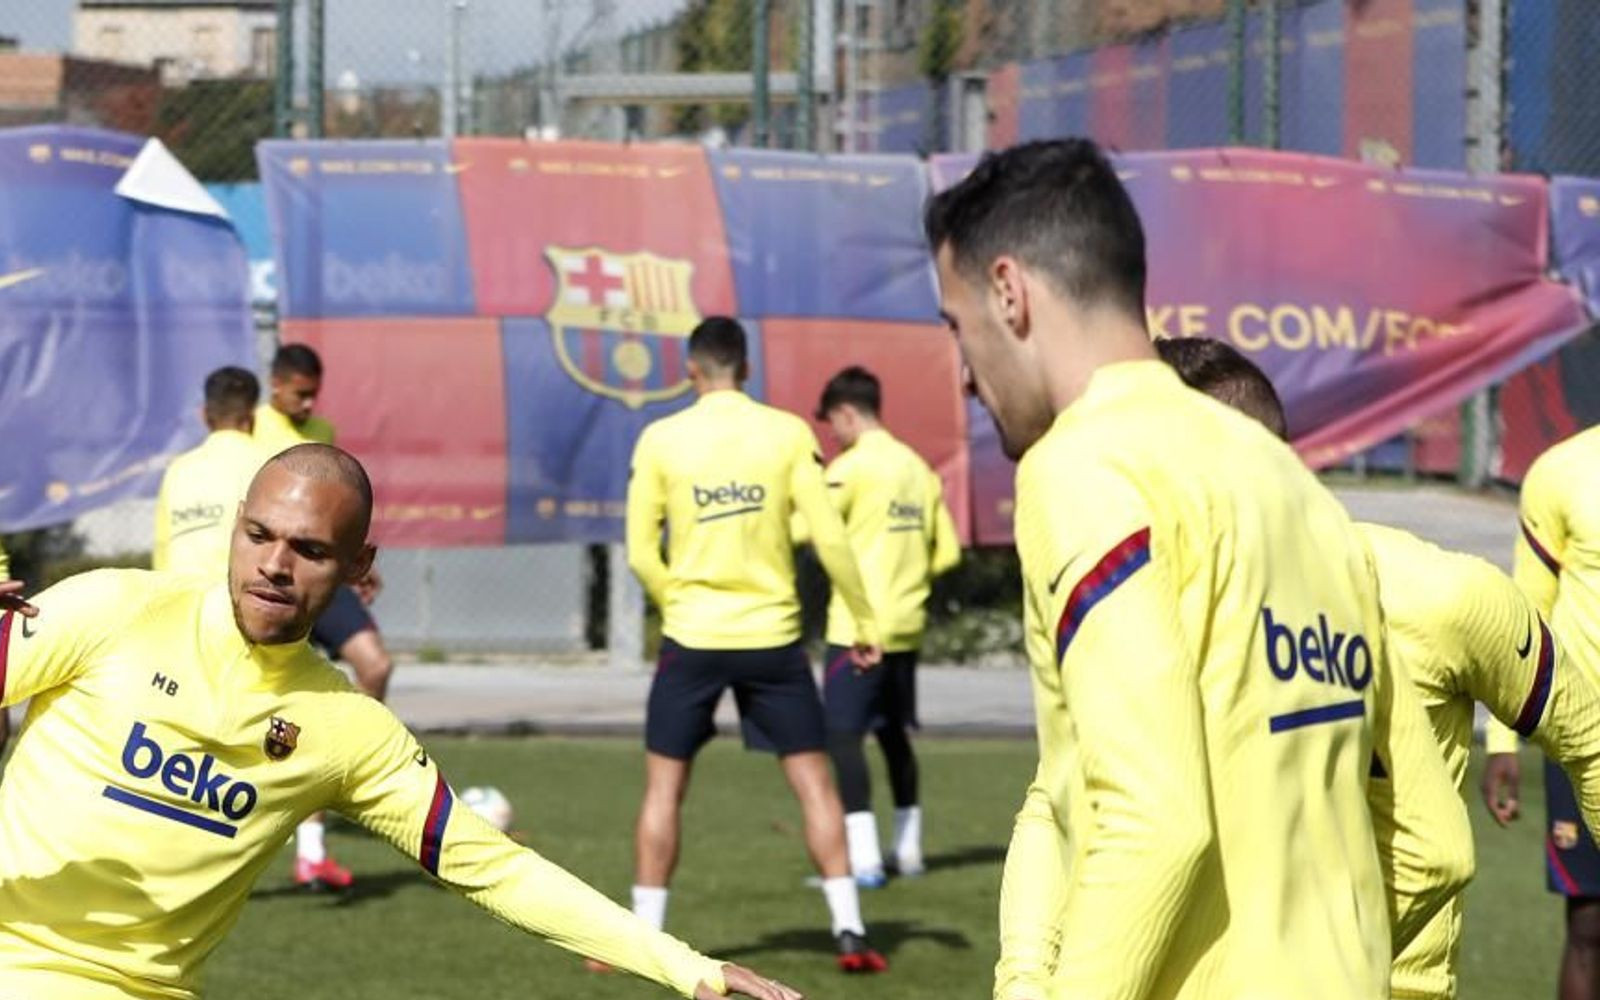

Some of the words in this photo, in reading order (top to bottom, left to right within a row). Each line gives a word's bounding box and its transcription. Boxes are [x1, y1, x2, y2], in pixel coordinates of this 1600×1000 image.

[693, 481, 765, 507] beko
[1262, 607, 1373, 692] beko
[121, 721, 258, 820] beko
